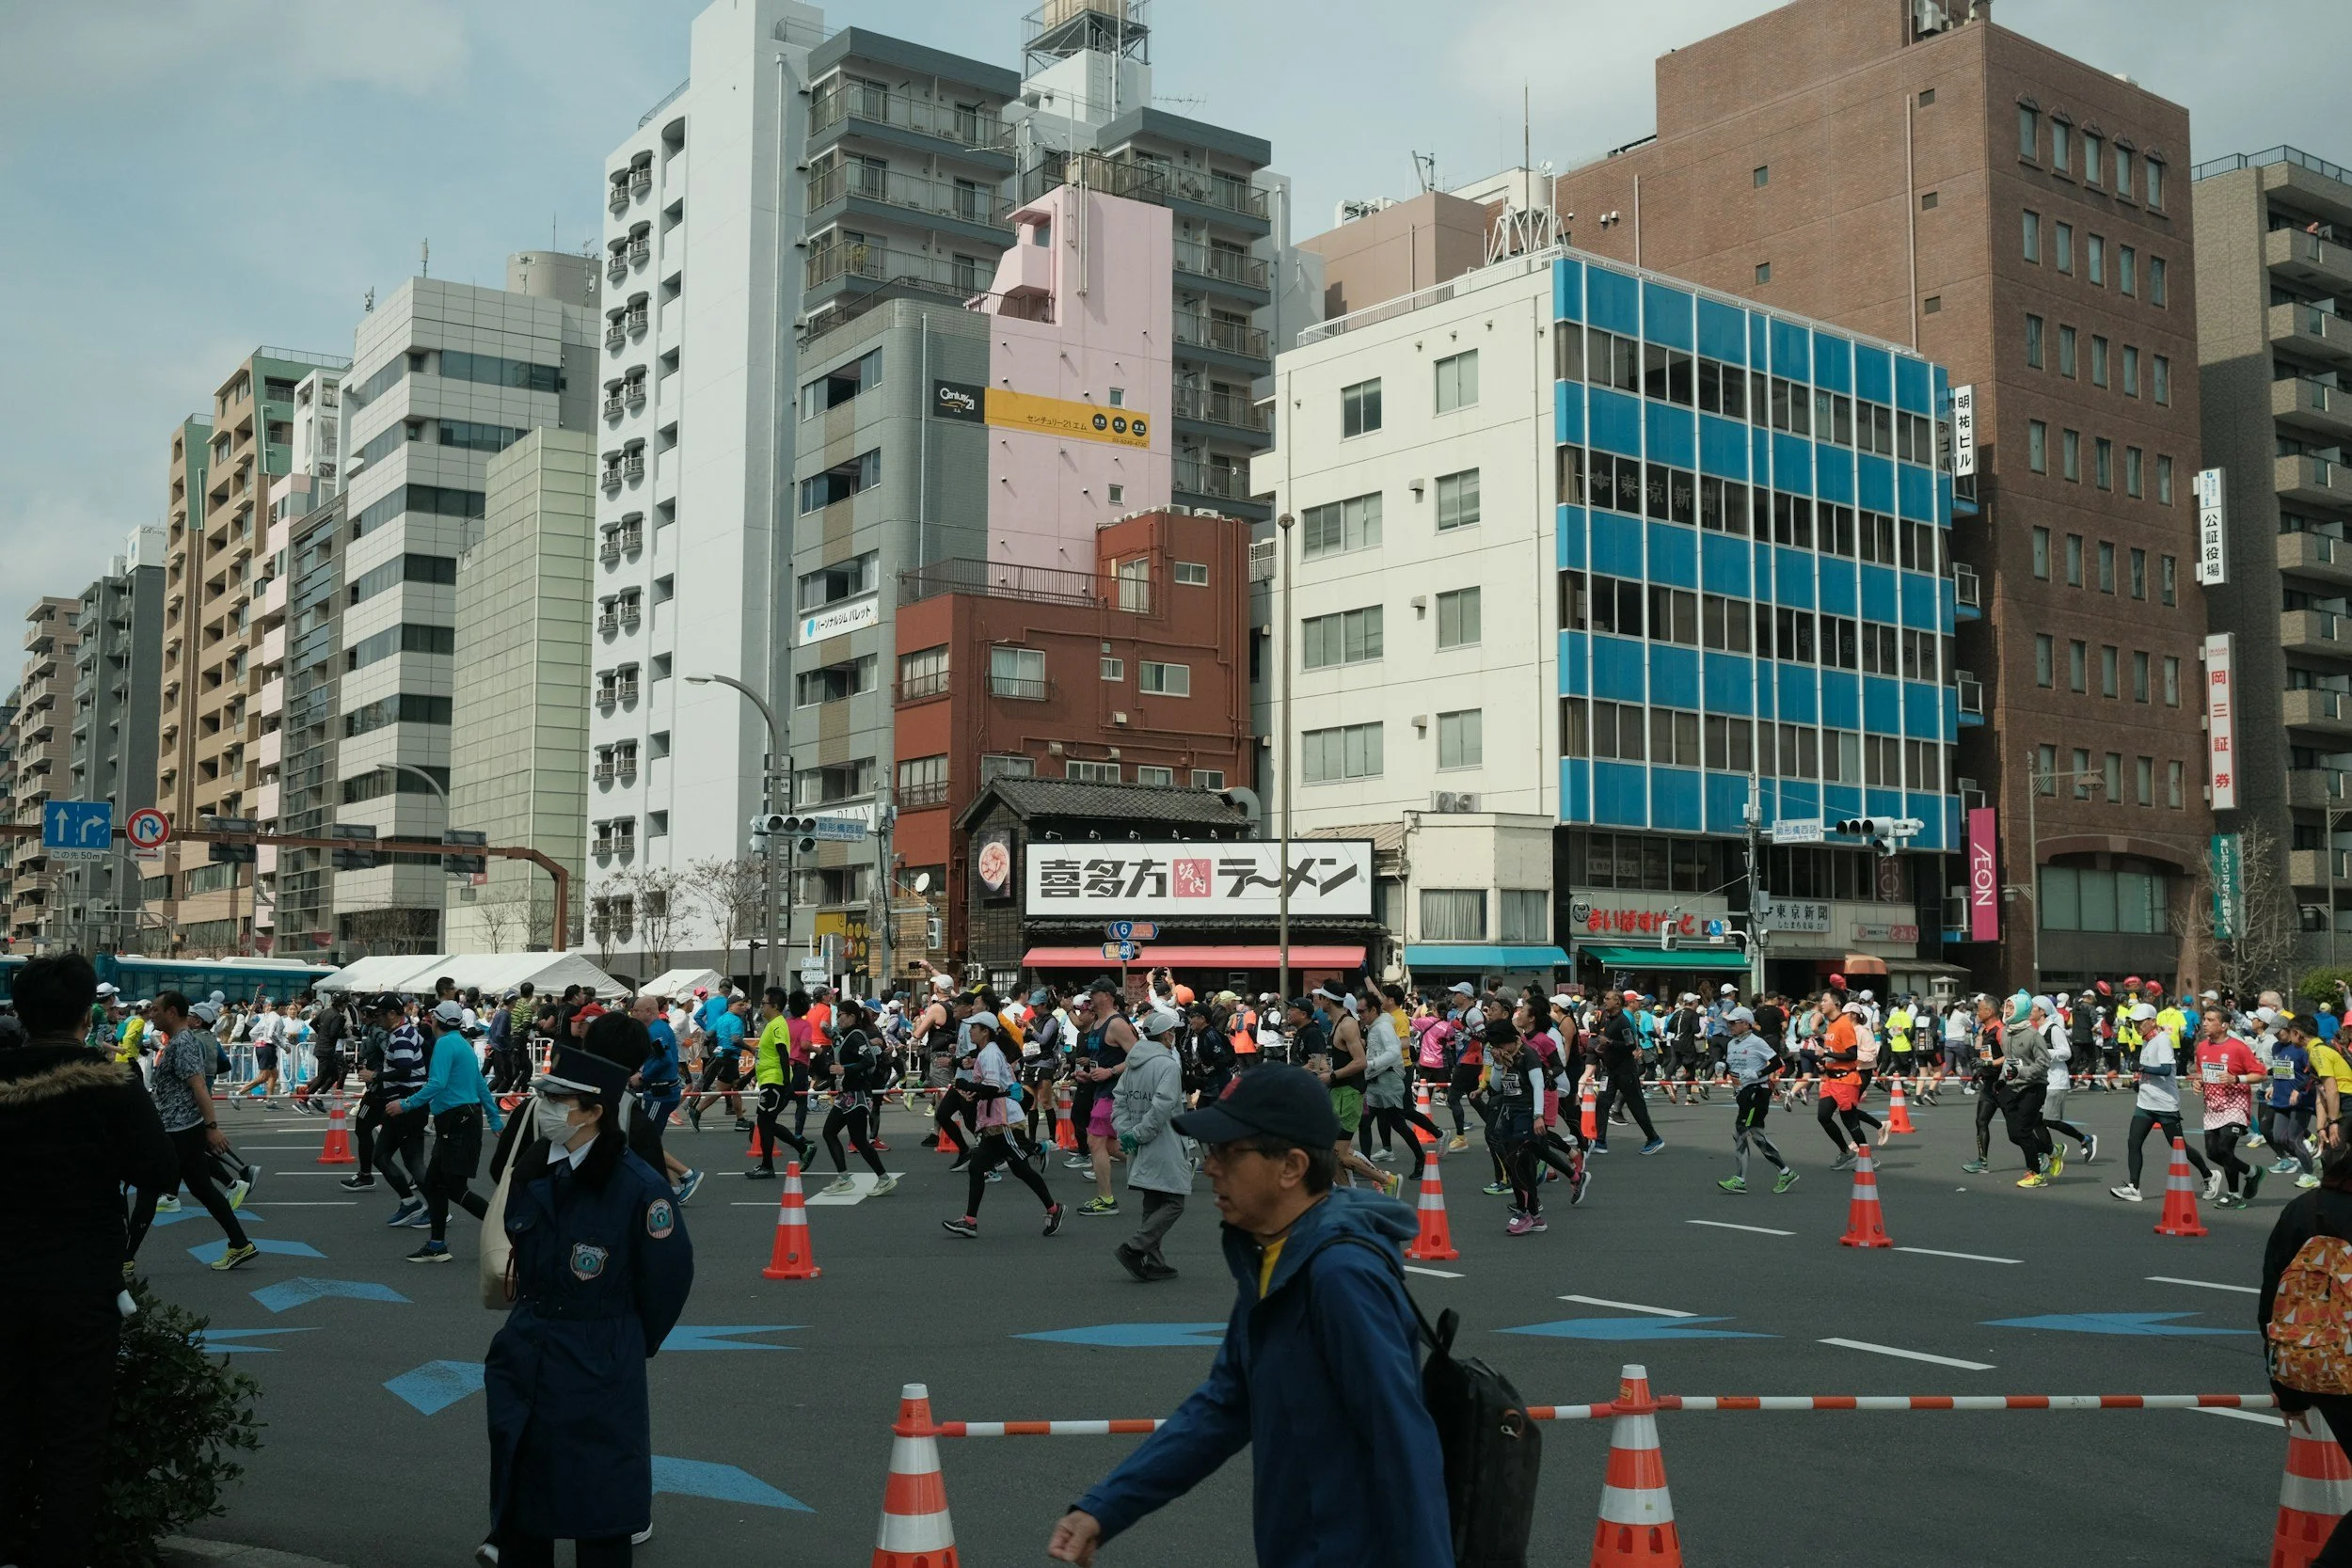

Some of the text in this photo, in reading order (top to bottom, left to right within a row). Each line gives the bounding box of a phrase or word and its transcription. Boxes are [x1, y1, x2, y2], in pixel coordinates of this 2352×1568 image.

[939, 387, 975, 410] Century 21
[1958, 394, 1971, 468] 明祐ビル
[2204, 514, 2220, 577] 公証役場
[849, 605, 871, 622] パレット
[2211, 670, 2231, 788] 岡三証券
[818, 823, 864, 834] 駒形橋西詰
[52, 851, 100, 861] この先 50m
[1040, 859, 1167, 898] 喜多方
[1178, 863, 1206, 895] 坂内
[1217, 858, 1358, 898] ラーメン
[1587, 908, 1695, 935] まいばすけと
[1775, 903, 1829, 921] 東京新聞
[1120, 924, 1128, 935] 6
